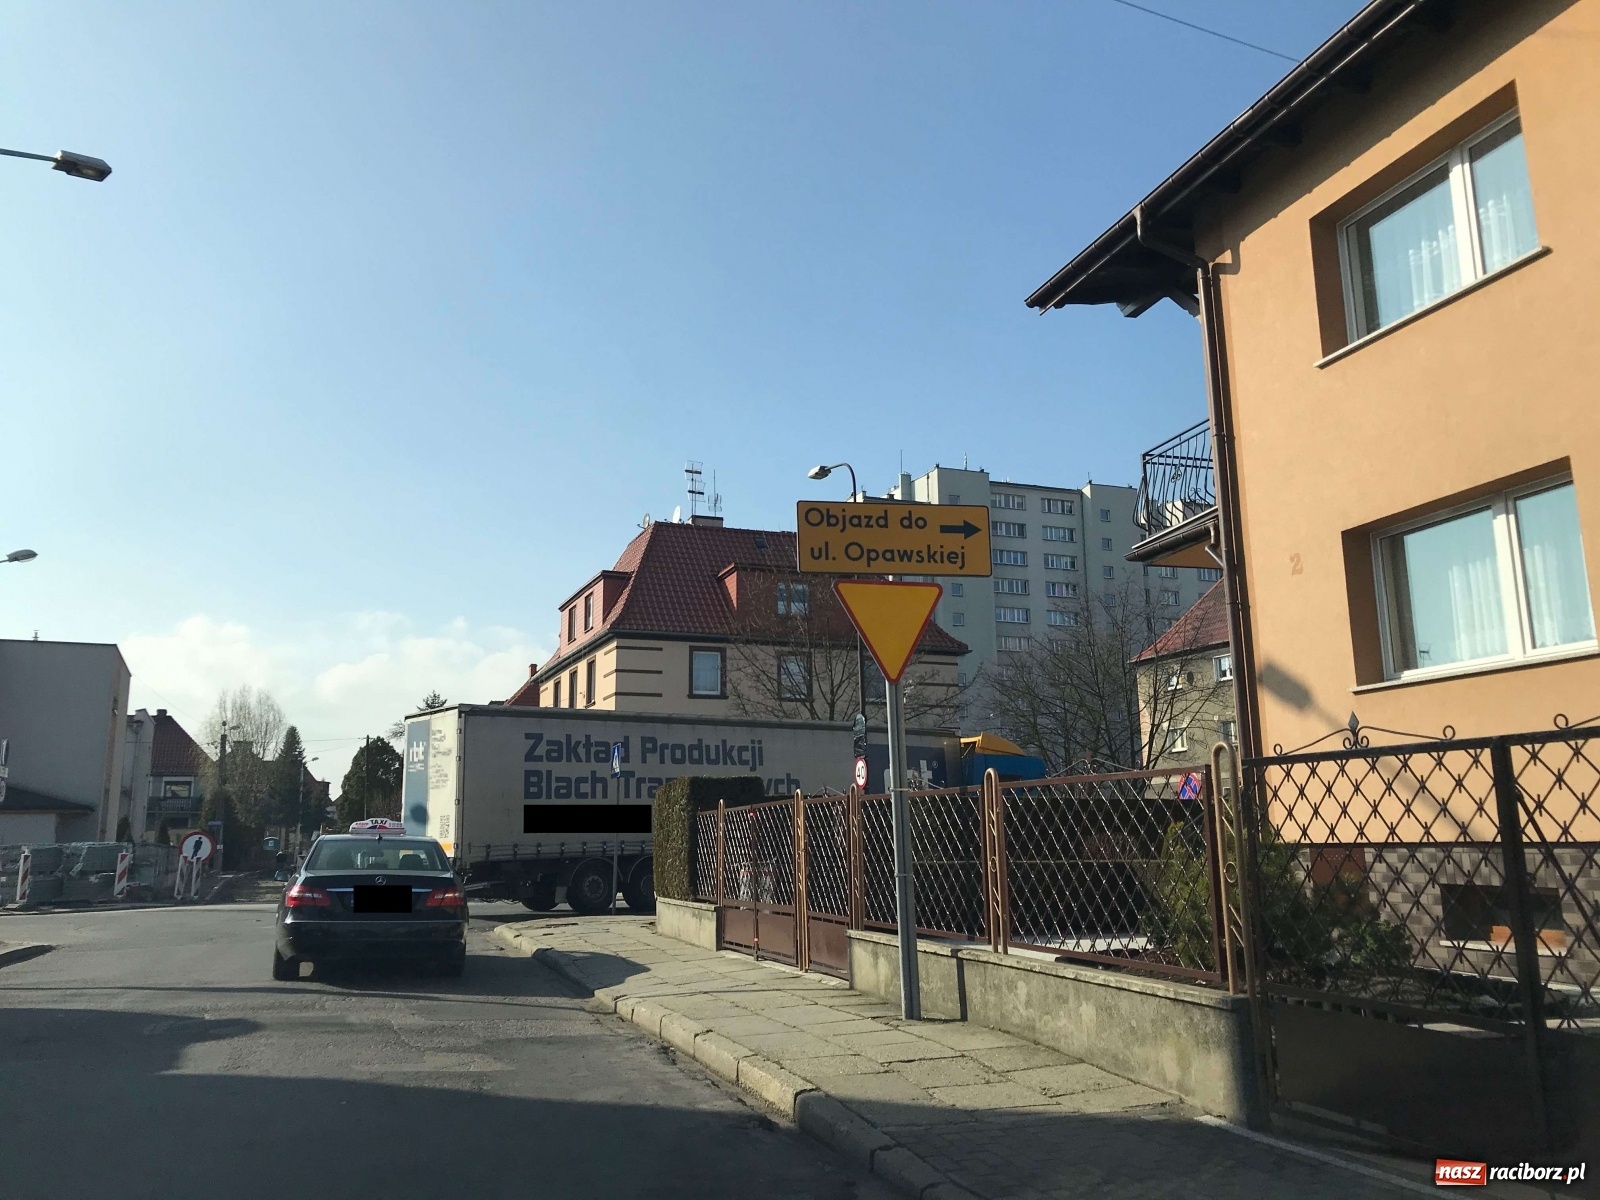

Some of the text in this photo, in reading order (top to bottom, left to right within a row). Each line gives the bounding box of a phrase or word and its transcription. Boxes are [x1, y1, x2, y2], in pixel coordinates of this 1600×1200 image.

[804, 507, 928, 533] Objazd do
[810, 541, 966, 570] ul. Opawskiej
[1290, 552, 1303, 576] 2
[524, 732, 764, 772] Zakład Produkcji
[524, 769, 608, 800] Blach
